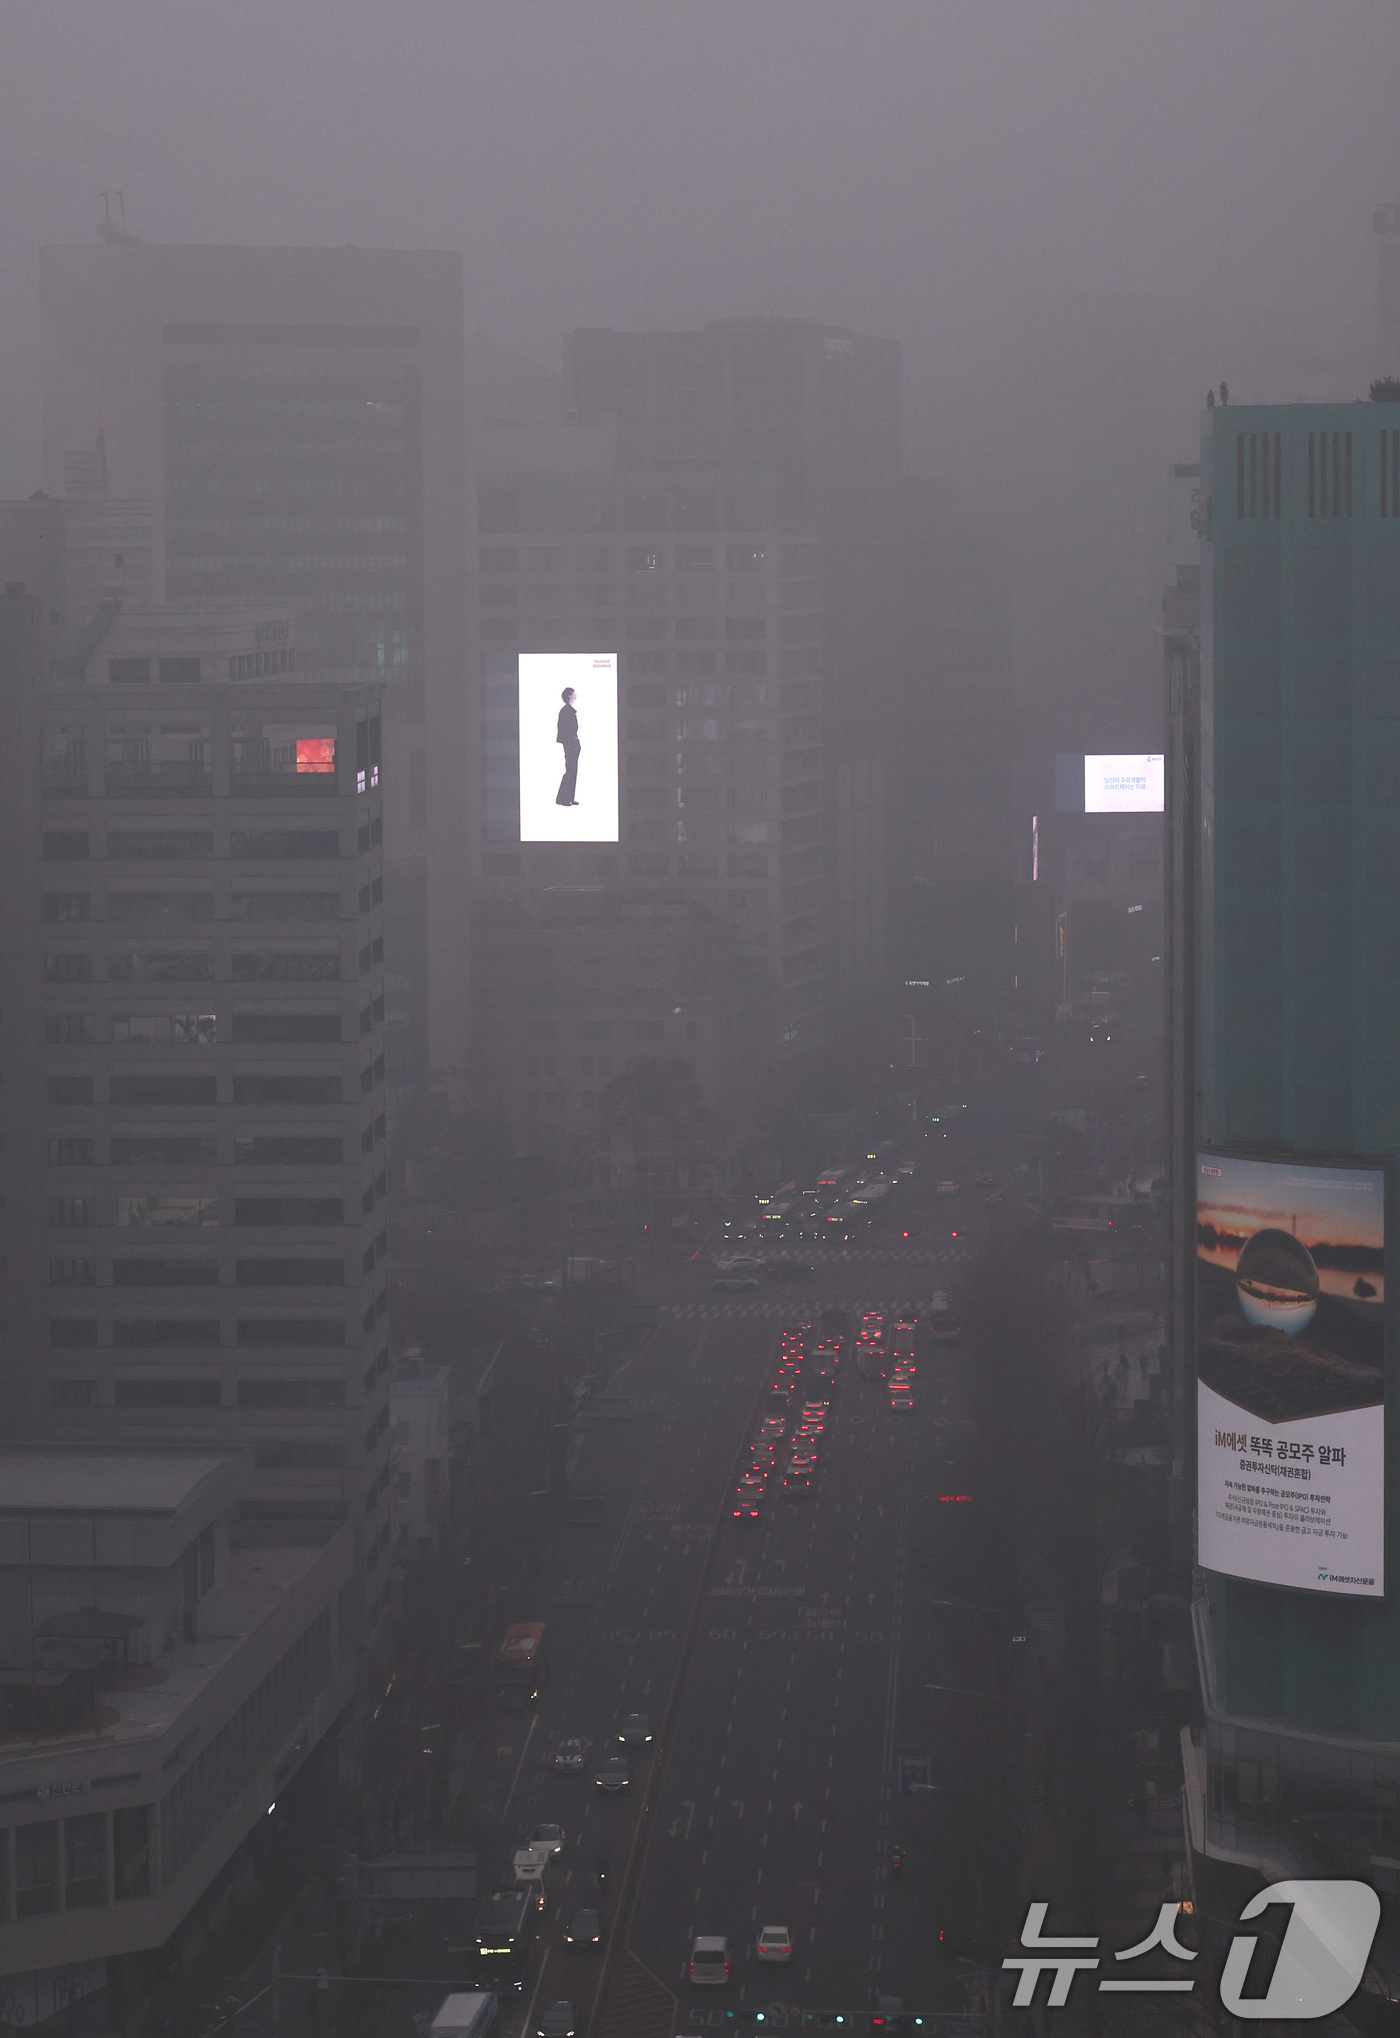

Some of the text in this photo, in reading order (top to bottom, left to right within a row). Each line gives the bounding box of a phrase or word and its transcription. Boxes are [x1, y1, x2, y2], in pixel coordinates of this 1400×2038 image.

[1215, 1429, 1347, 1467] iM에셋 똑똑 공모주 알파
[1239, 1459, 1311, 1480] 증권투자신탁(채권혼합)
[1224, 1480, 1331, 1504] 지속 가능한 알파를 추구하는 공모주(IPO) 투자전략
[1247, 1506, 1252, 1514] 및
[1284, 1512, 1298, 1521] 투자의
[1300, 1515, 1331, 1526] 콜라보레이션
[1255, 1499, 1263, 1507] IPO
[1294, 1505, 1309, 1514] SPAC)
[1311, 1507, 1326, 1516] 투자와
[1285, 1524, 1300, 1534] 준용한
[1301, 1527, 1311, 1535] 금고
[1312, 1528, 1324, 1537] 자금
[1325, 1530, 1336, 1538] 투자
[1337, 1531, 1348, 1540] 가능
[1329, 1574, 1375, 1586] iM에셋자산운용
